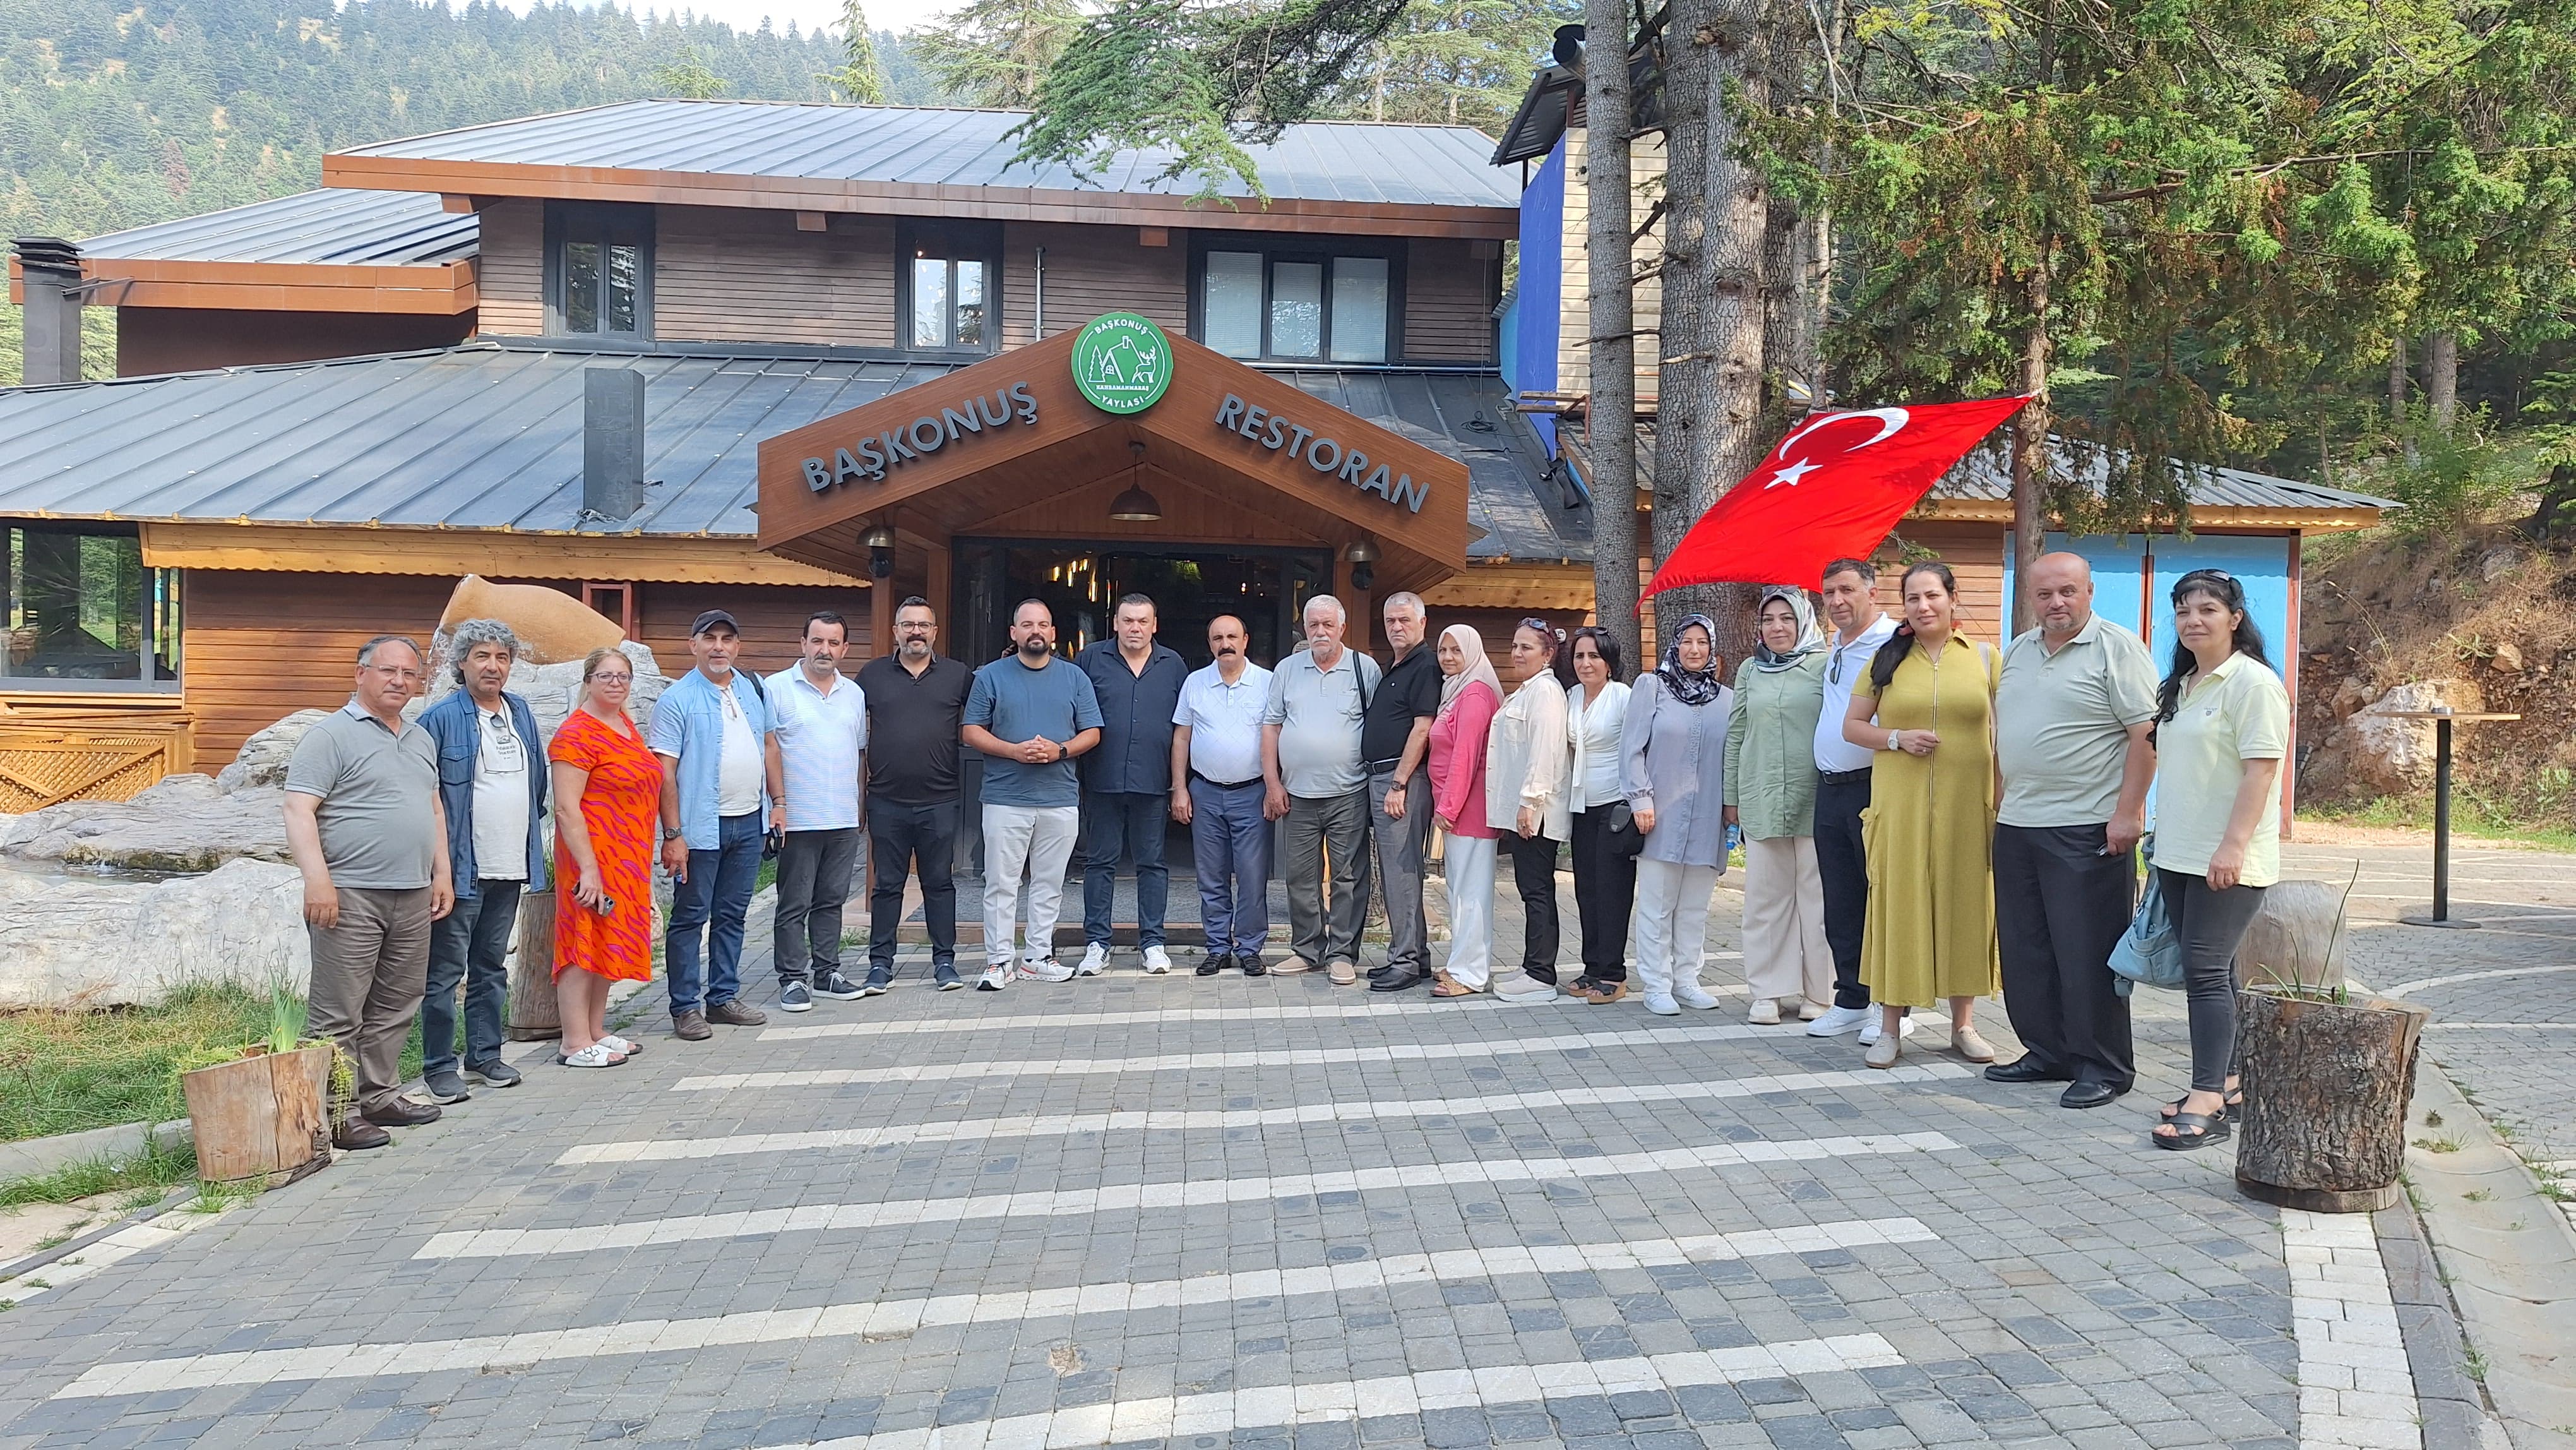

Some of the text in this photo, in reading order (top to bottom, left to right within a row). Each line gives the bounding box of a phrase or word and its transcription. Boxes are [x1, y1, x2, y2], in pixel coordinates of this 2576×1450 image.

[1094, 319, 1148, 335] BAŞKONUŞ
[1102, 395, 1144, 407] YAYLASI
[801, 381, 1429, 513] BAŞKONUŞ RESTORAN
